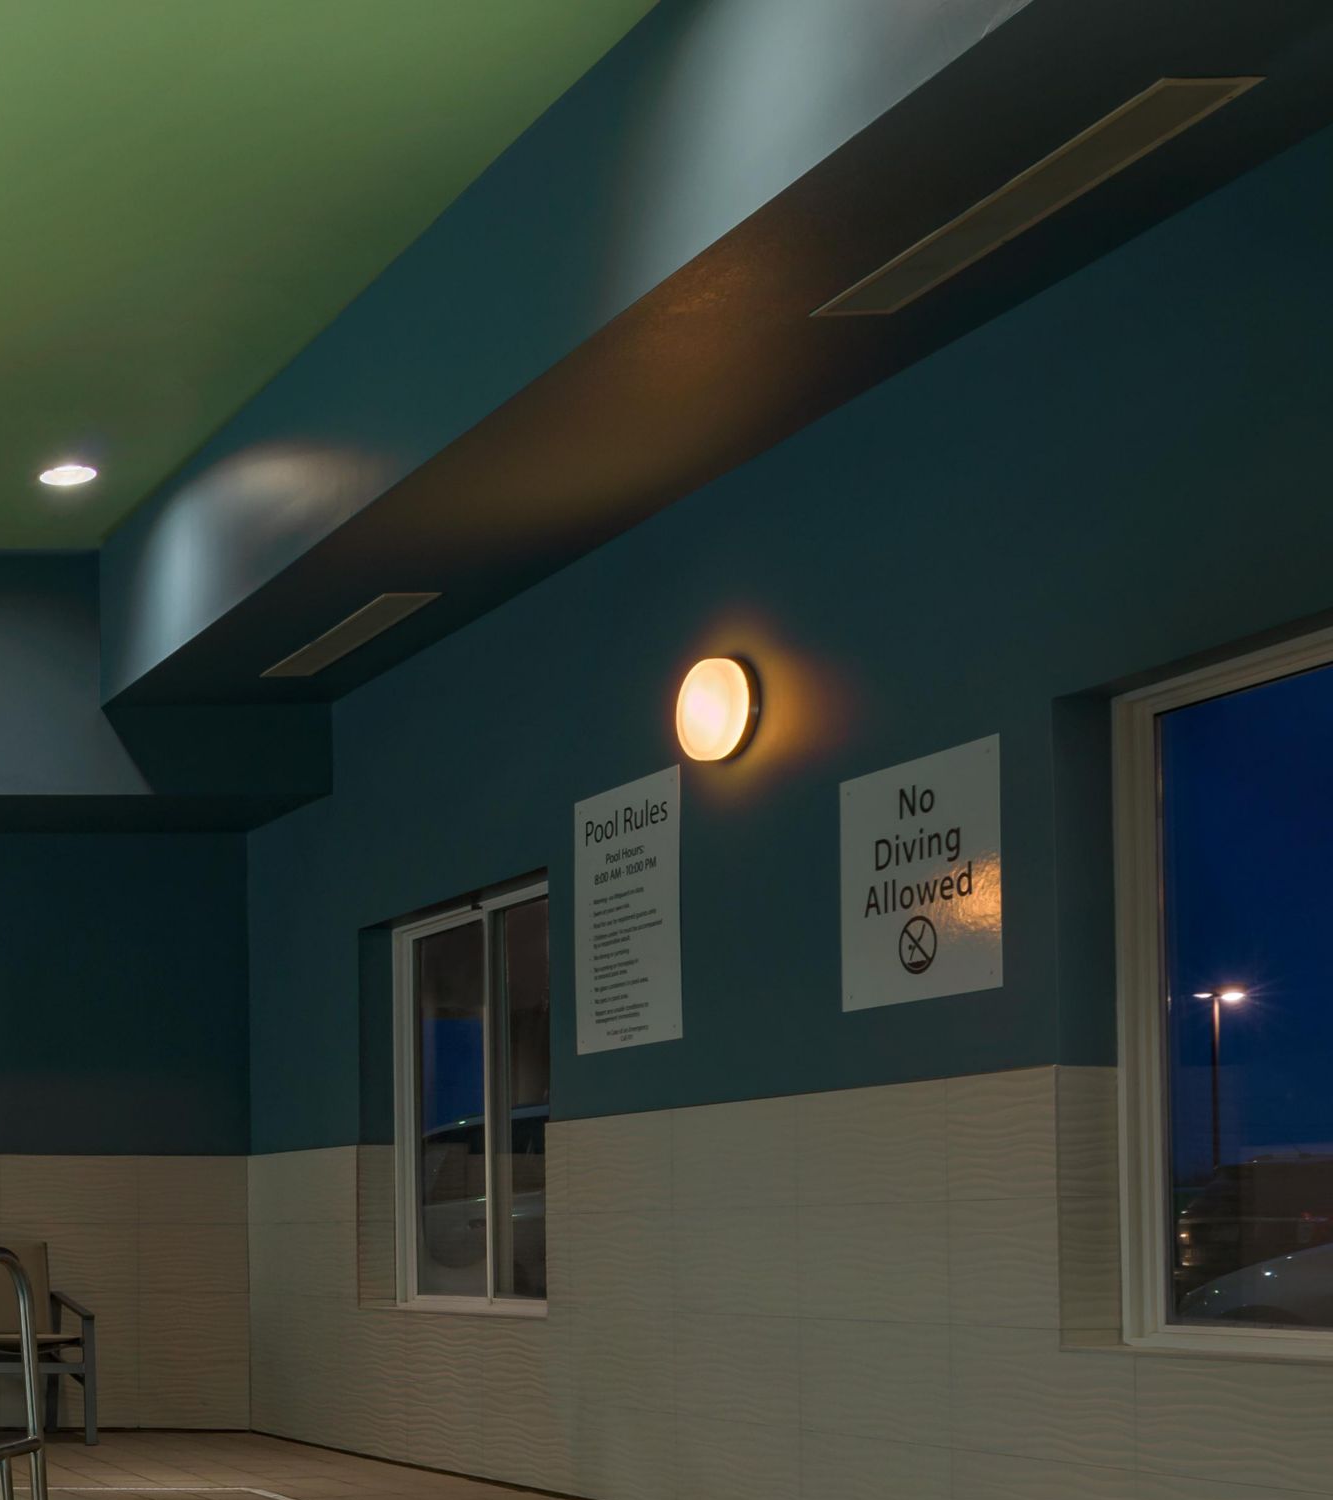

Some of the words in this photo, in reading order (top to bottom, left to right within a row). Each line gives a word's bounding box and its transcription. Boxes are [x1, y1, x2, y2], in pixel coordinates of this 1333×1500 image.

[899, 784, 935, 820] No
[585, 810, 618, 847] Pool
[624, 799, 668, 834] Rules
[605, 849, 621, 865] Pool
[875, 826, 962, 872] Diving
[594, 871, 609, 885] 8:00
[610, 867, 621, 880] AM
[626, 861, 644, 875] 10:00
[645, 856, 657, 869] PM
[864, 862, 973, 919] Allowed
